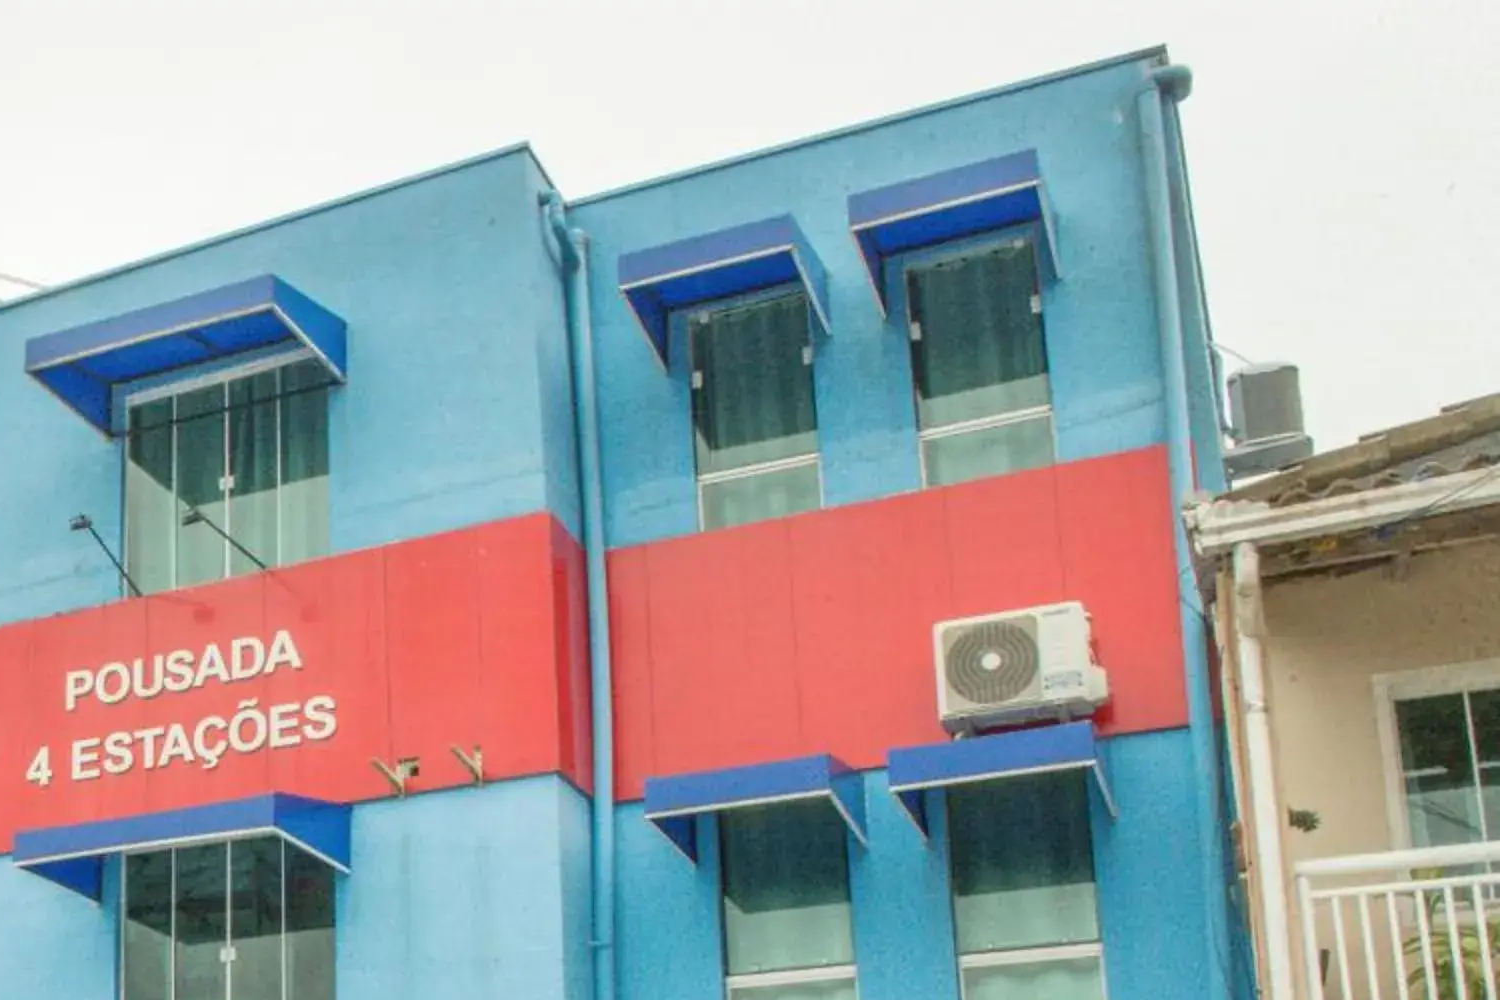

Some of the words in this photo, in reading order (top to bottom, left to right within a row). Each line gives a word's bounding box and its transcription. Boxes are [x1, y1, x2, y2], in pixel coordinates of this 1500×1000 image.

[65, 630, 304, 711] POUSADA
[25, 746, 52, 786] 4
[71, 695, 338, 780] ESTAÇÕES
